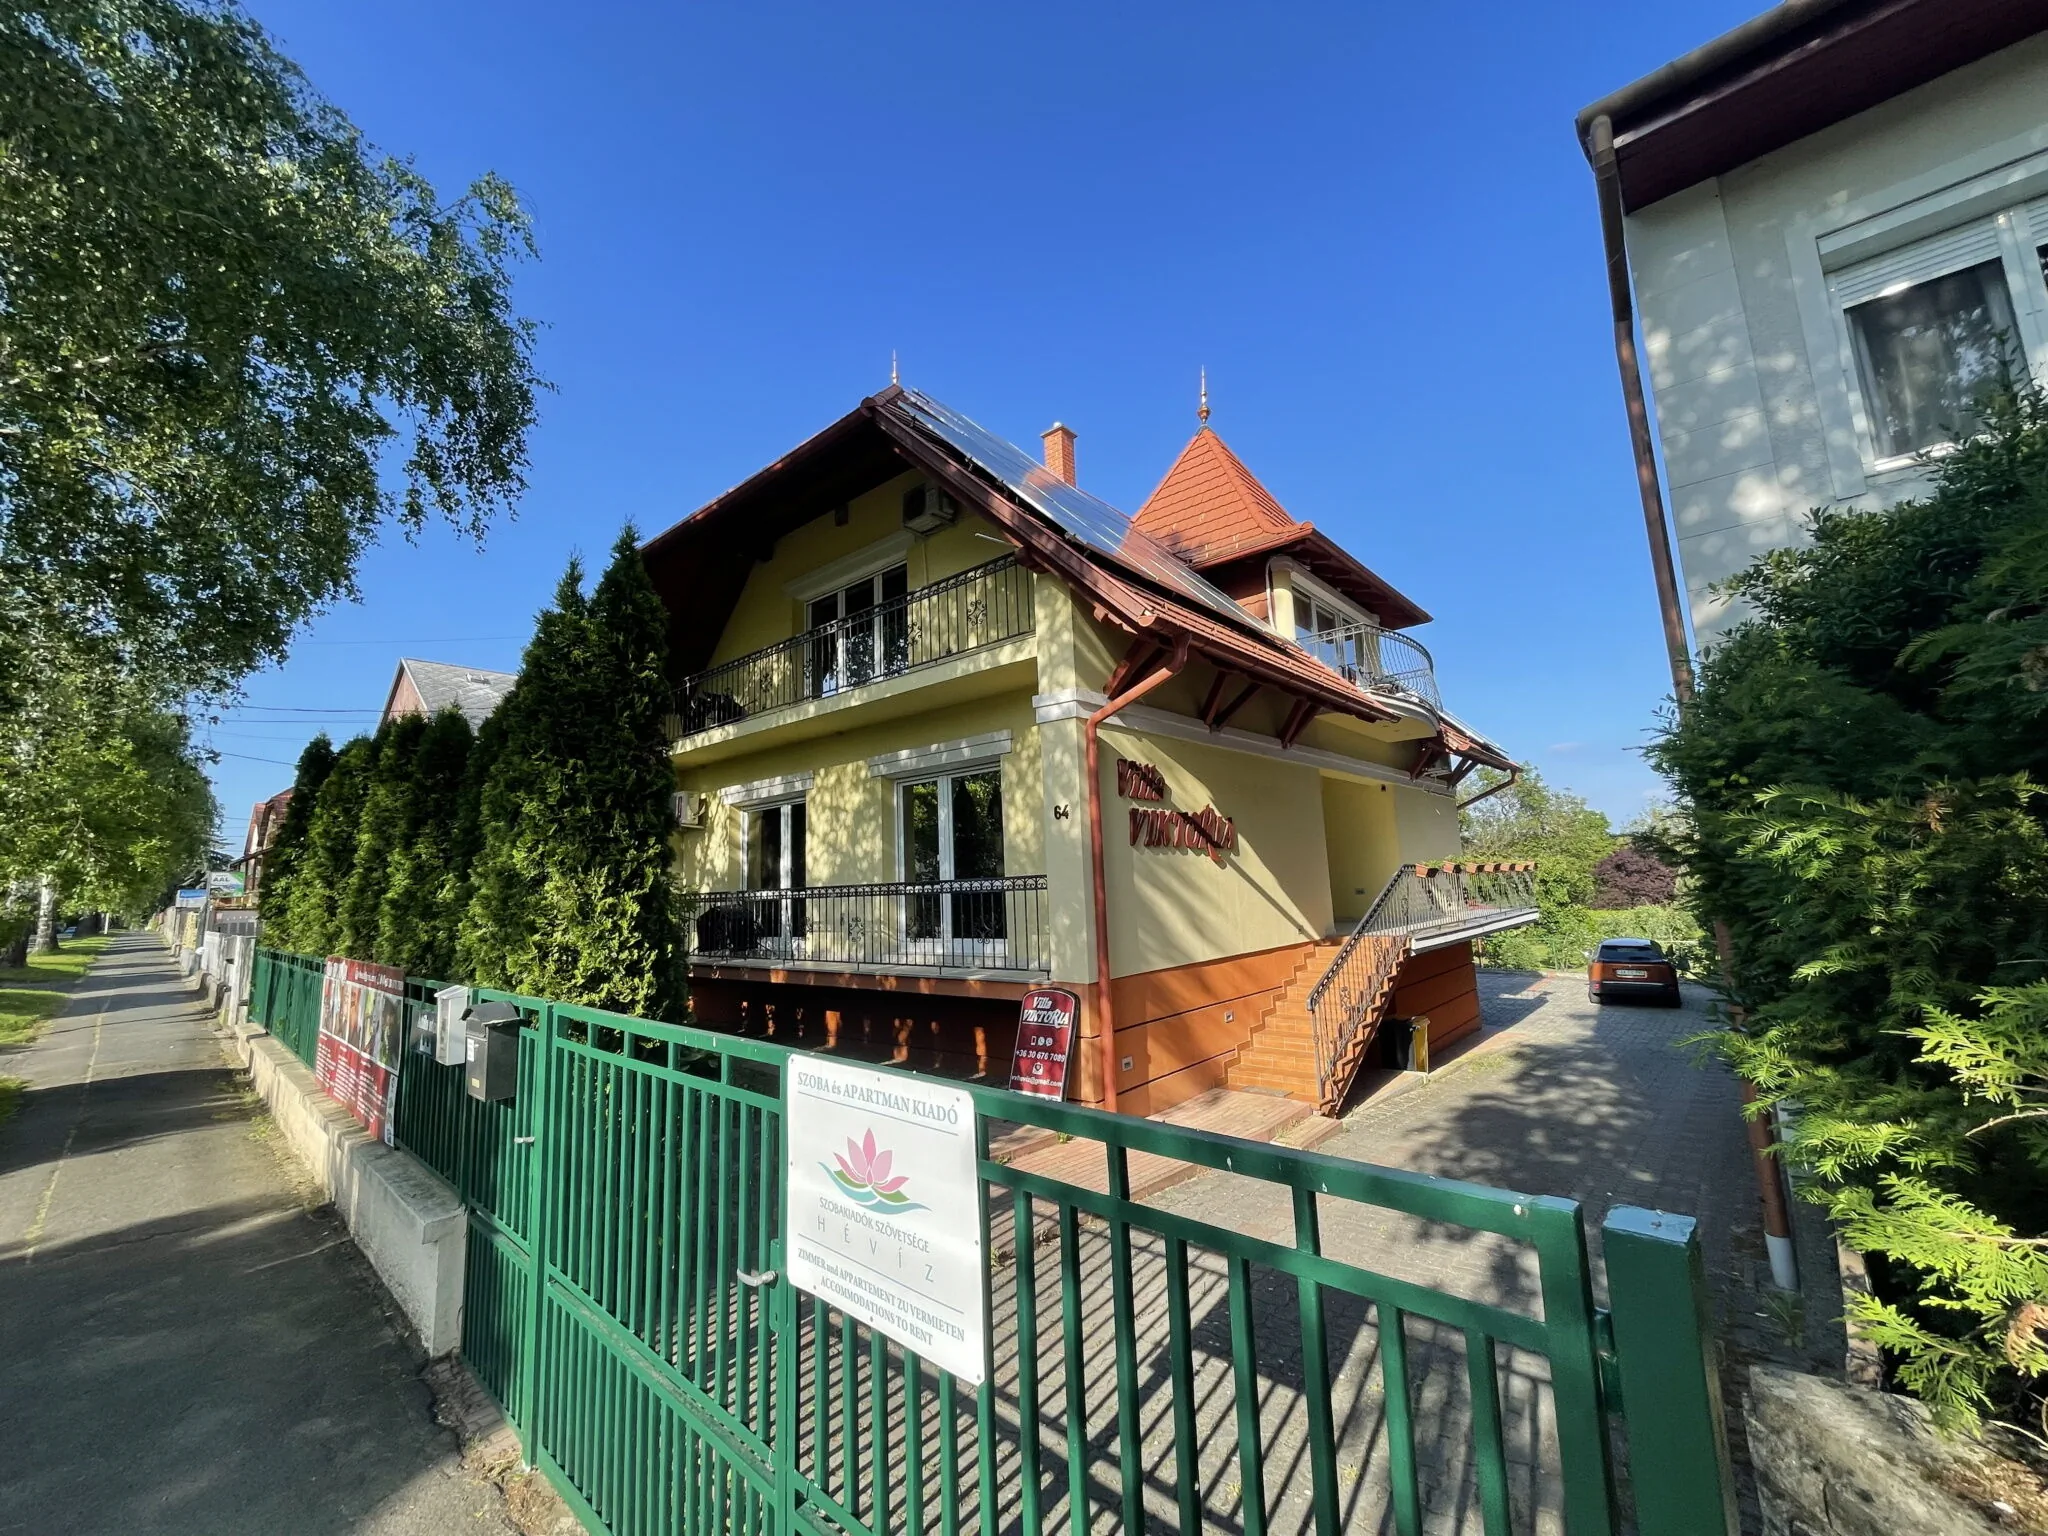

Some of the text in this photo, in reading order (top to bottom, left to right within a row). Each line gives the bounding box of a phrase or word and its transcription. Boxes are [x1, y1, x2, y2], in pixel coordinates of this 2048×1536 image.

[1117, 758, 1166, 801] Villa
[1054, 804, 1069, 820] 64
[1128, 804, 1236, 863] VIKTORIA
[1022, 1008, 1070, 1029] VIKTORIA
[1033, 996, 1053, 1009] Villa
[1028, 1050, 1037, 1058] 30
[797, 1072, 959, 1125] SZOBA és APARTMAN KIADÓ
[819, 1196, 930, 1253] SZOBAKIADÓK SZÖVETSÉGE
[797, 1247, 965, 1342] ZIMMER und APPARTEMENT ZU VERMIETEN
[820, 1275, 934, 1346] ACCOMMODATIONS TO RENT
